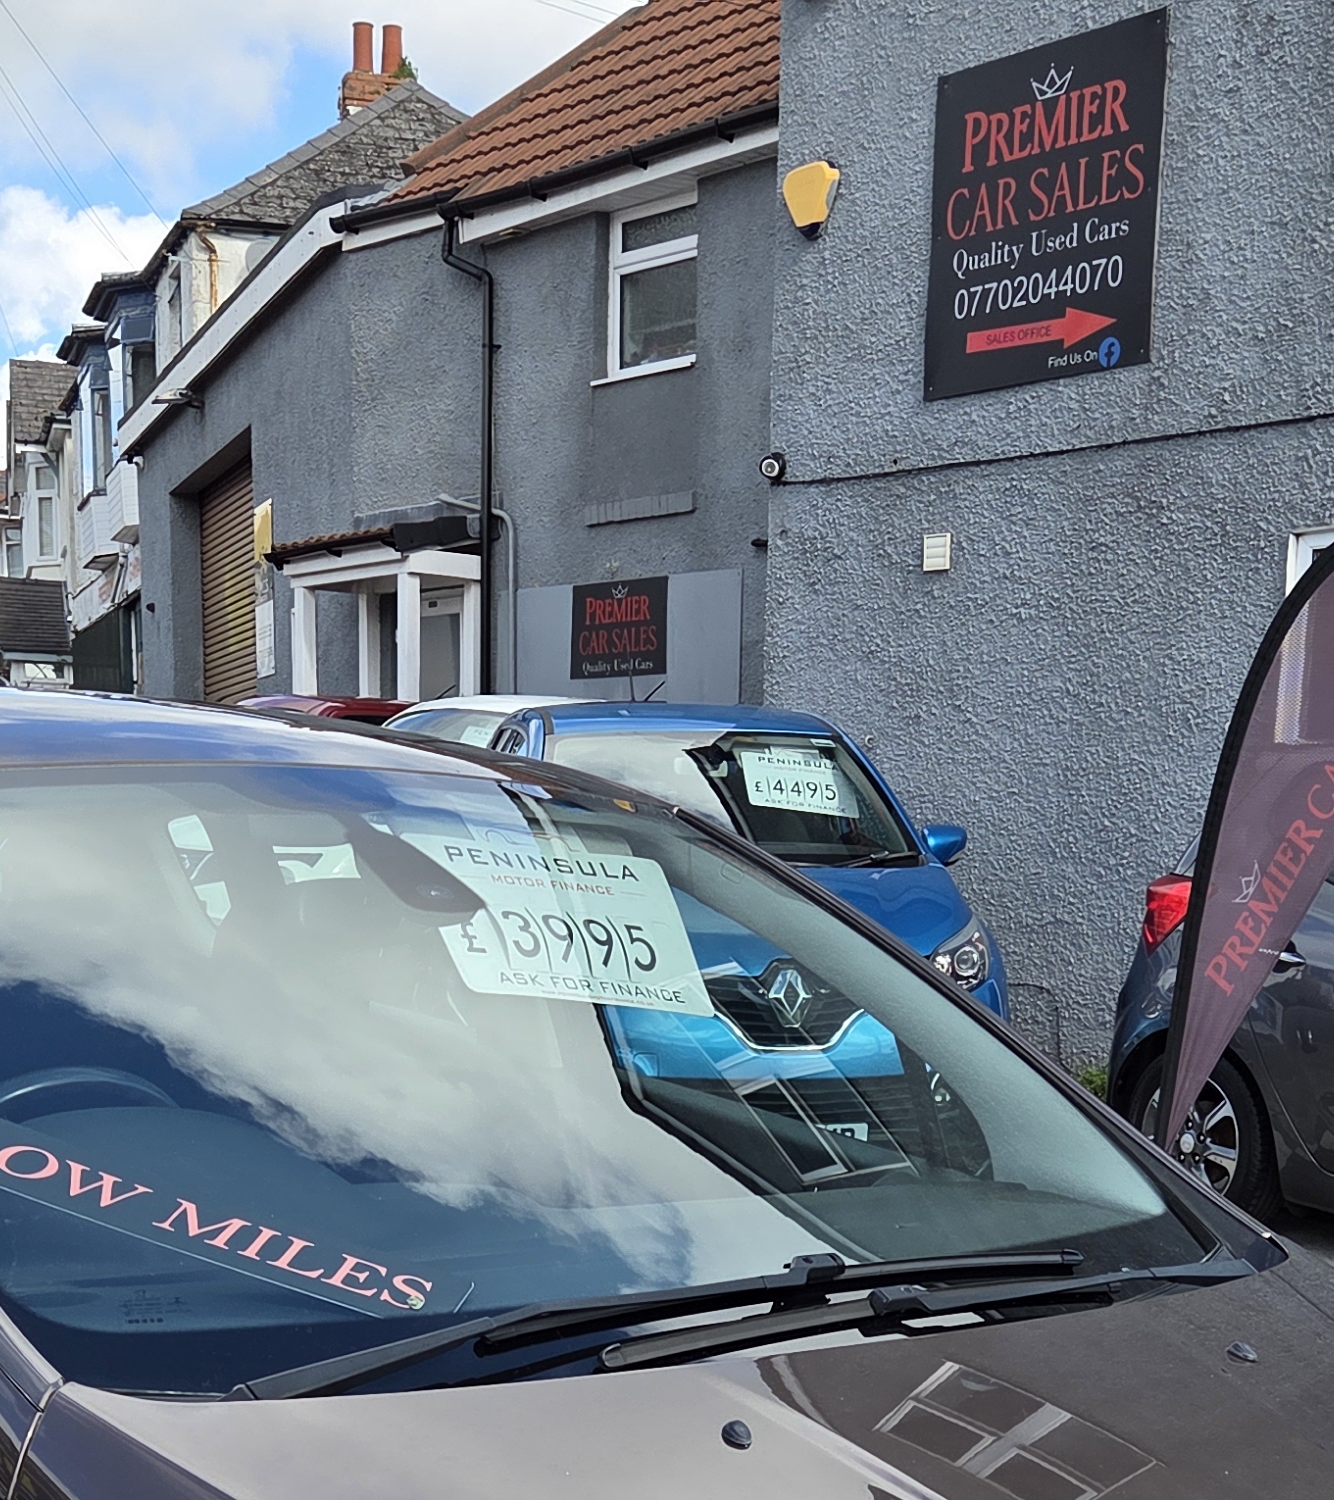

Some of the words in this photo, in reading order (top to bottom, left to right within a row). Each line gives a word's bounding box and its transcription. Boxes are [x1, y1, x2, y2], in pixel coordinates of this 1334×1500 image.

[962, 79, 1130, 173] PREMIER
[946, 176, 1019, 240] CAR
[1028, 143, 1145, 222] SALES
[952, 242, 1024, 280] Quality
[1031, 224, 1078, 257] Used
[1085, 217, 1130, 243] Cars
[954, 255, 1123, 320] 07702044070
[986, 331, 1015, 345] SALES
[1017, 325, 1052, 340] OFFICE
[1048, 354, 1067, 368] Find
[1069, 353, 1082, 364] Us
[1083, 350, 1098, 362] On
[585, 595, 650, 625] PREMIER
[579, 630, 609, 655] CAR
[612, 625, 657, 654] SALES
[582, 660, 611, 676] Quality
[614, 658, 633, 671] Used
[635, 657, 653, 670] Cars
[757, 756, 840, 772] PENINSULA
[443, 844, 641, 882] PENINSULA
[491, 873, 545, 889] MOTOR
[550, 879, 616, 896] FINANCE
[1204, 818, 1323, 997] PREMIER
[500, 971, 545, 987] ASK
[550, 976, 592, 993] FOR
[599, 981, 686, 1004] FINANCE
[152, 1198, 433, 1310] MILES
